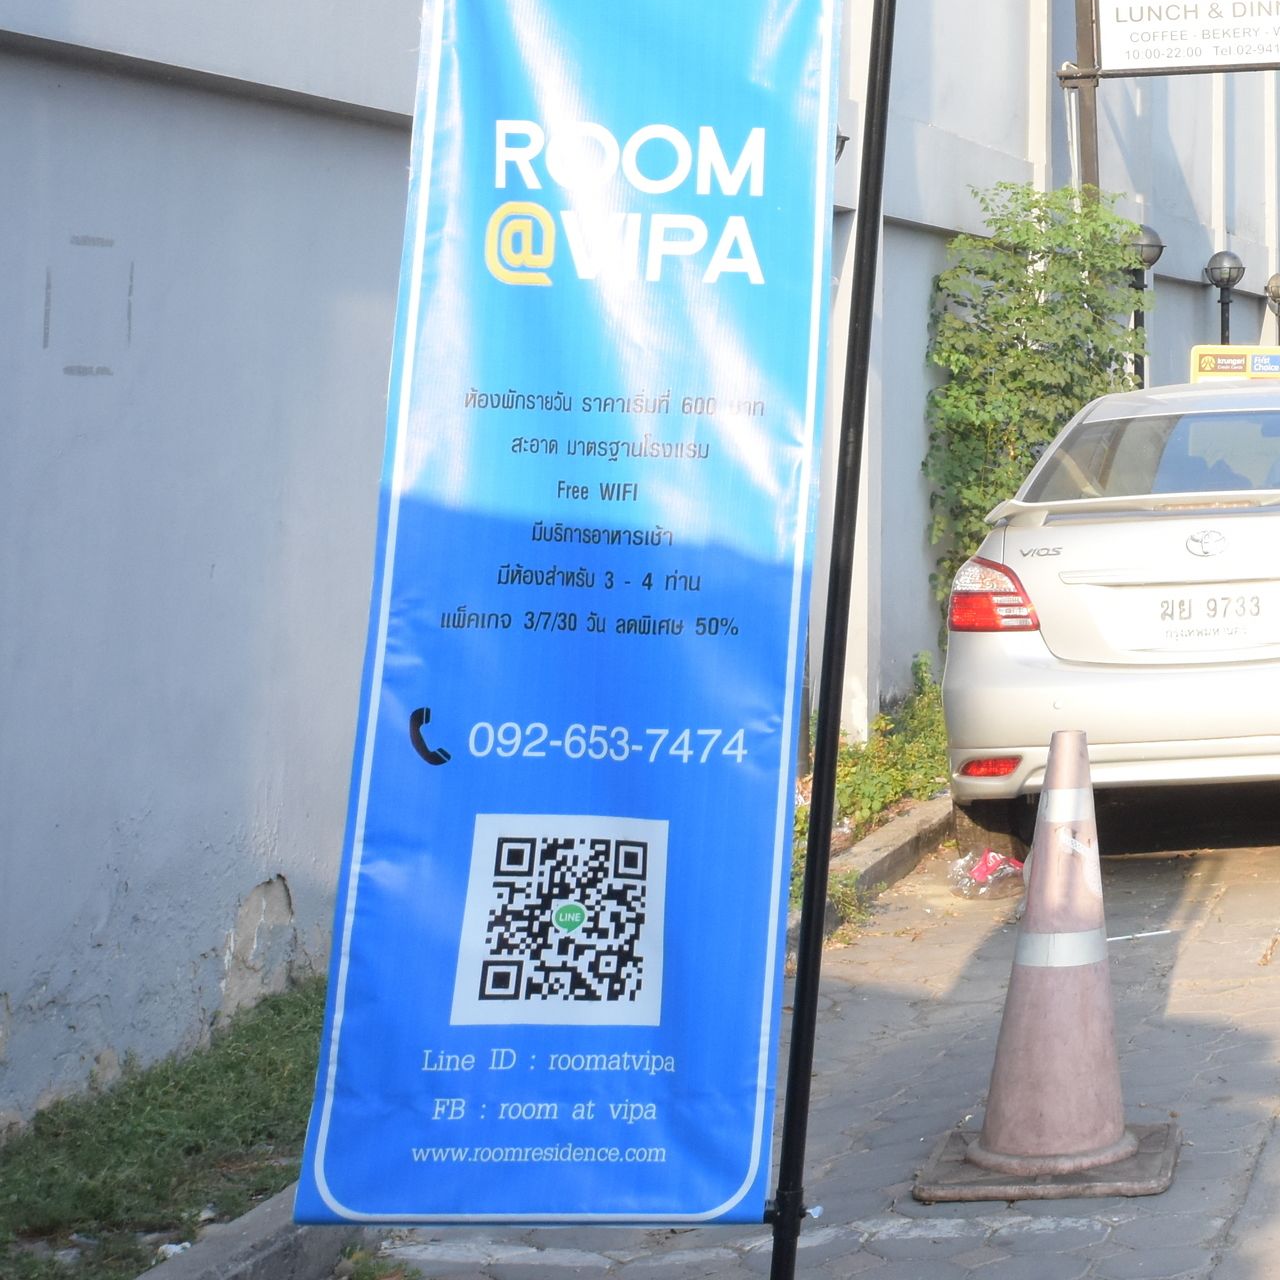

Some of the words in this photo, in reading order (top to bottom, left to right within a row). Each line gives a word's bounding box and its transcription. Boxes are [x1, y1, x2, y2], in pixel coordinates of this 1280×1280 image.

[1116, 2, 1199, 23] LUNCH
[1208, 2, 1224, 19] &
[1130, 30, 1188, 43] COFFEE
[1202, 27, 1261, 40] BEKERY
[493, 119, 766, 197] ROOM
[484, 200, 766, 288] @VIPA
[1254, 363, 1279, 371] Choice
[464, 388, 572, 413] ห้องพักรายวัน
[581, 389, 671, 415] ราคาเริ่มที่
[681, 396, 717, 416] 600
[511, 437, 558, 455] สะอาด
[567, 434, 709, 463] มาตรฐานโรงแรม
[557, 481, 589, 500] Free
[600, 483, 638, 502] WIFI
[531, 521, 673, 547] มีบริการอาหารเช้า
[1020, 547, 1063, 558] VIOS
[497, 566, 596, 589] มีห้องสำหรับ
[604, 573, 614, 589] 3
[642, 574, 653, 591] 4
[664, 570, 700, 592] ท่าน
[1207, 596, 1261, 618] 9733
[440, 609, 512, 631] แพ็คเกจ
[524, 613, 577, 631] 3/7/30
[586, 612, 606, 633] วัน
[615, 615, 683, 637] ลดพิเศษ
[695, 617, 739, 637] 50%
[468, 722, 748, 763] 092-653-7474
[559, 912, 581, 923] LINE
[422, 1048, 475, 1072] Line
[489, 1048, 516, 1070] ID
[548, 1050, 676, 1074] roomatvipa
[432, 1098, 465, 1120] FB
[497, 1102, 558, 1120] room
[571, 1101, 595, 1120] at
[609, 1099, 657, 1122] vipa
[412, 1143, 667, 1163] www.roomresidence.com
